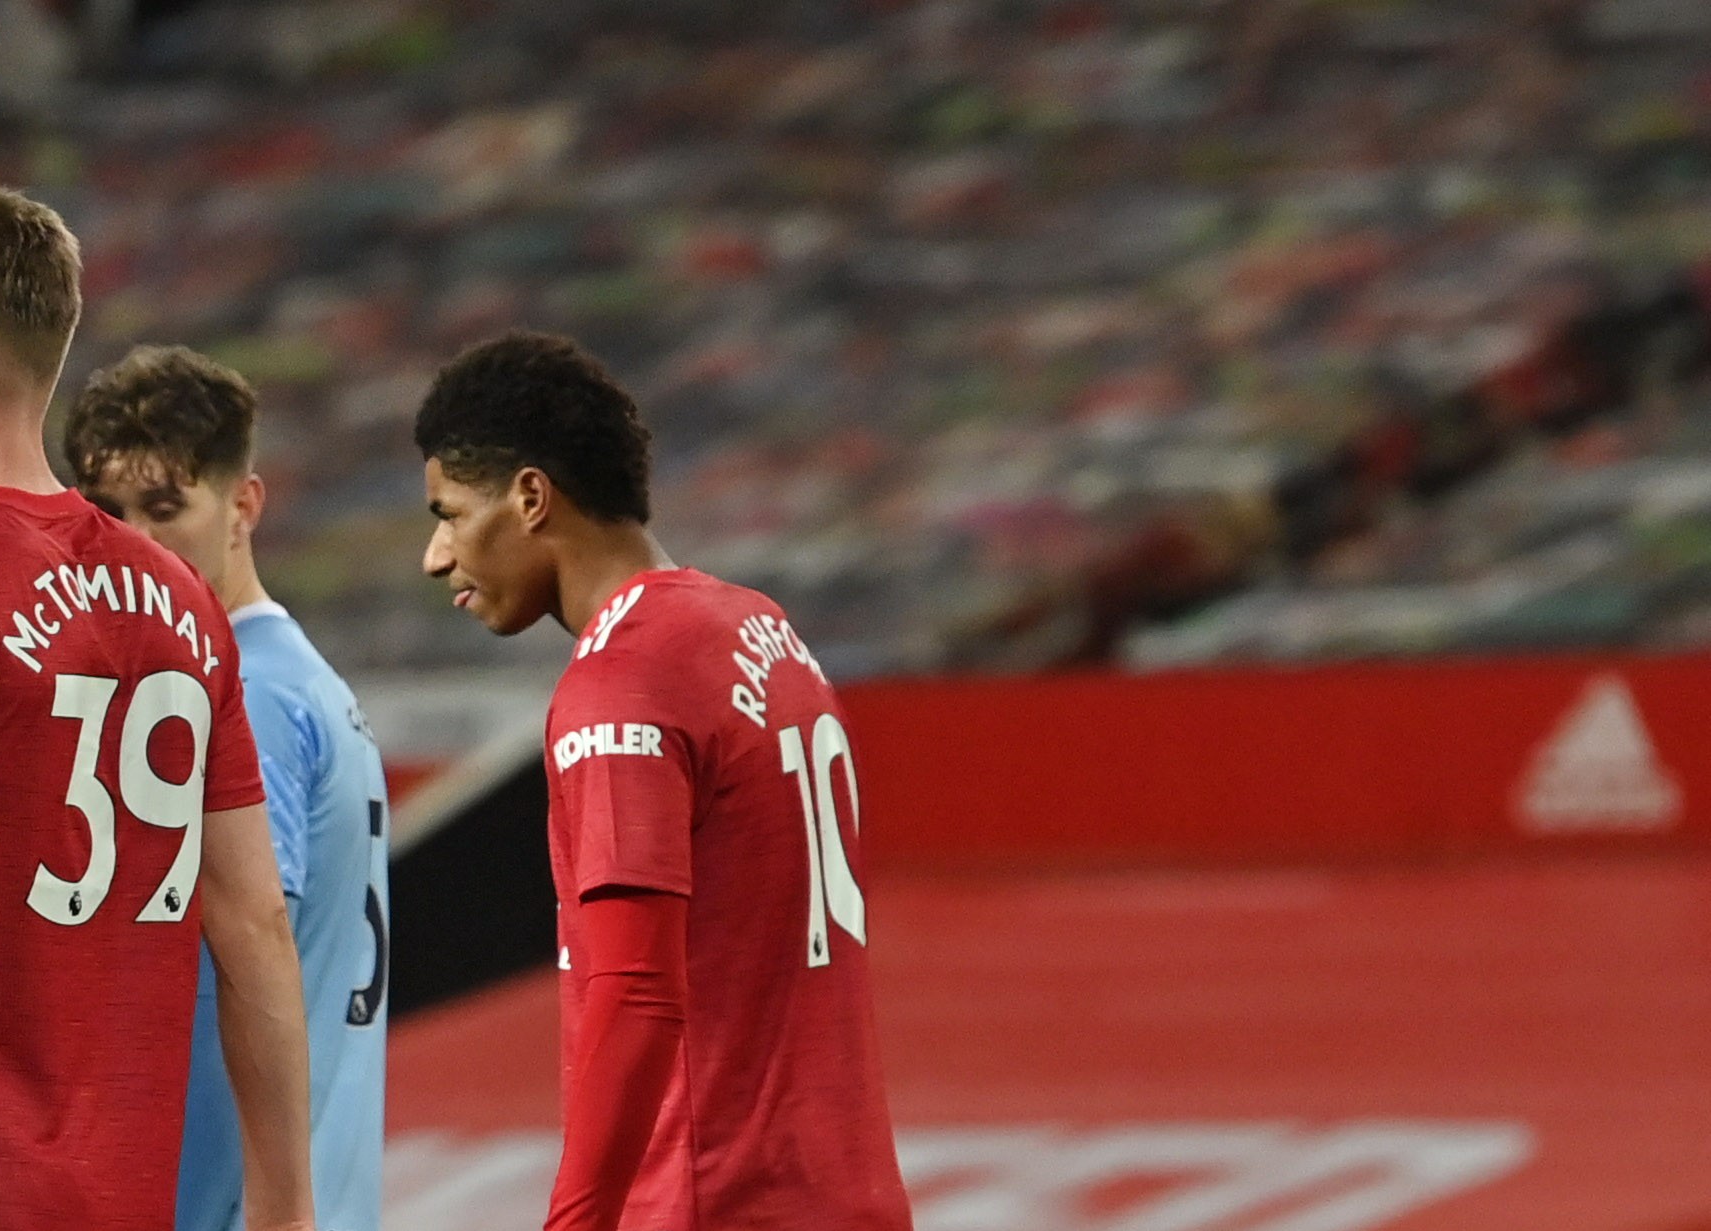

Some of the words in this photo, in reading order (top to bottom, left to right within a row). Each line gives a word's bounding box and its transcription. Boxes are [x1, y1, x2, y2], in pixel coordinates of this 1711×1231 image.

[26, 669, 213, 926] 39
[553, 722, 664, 774] KOHLER
[777, 712, 867, 968] 10
